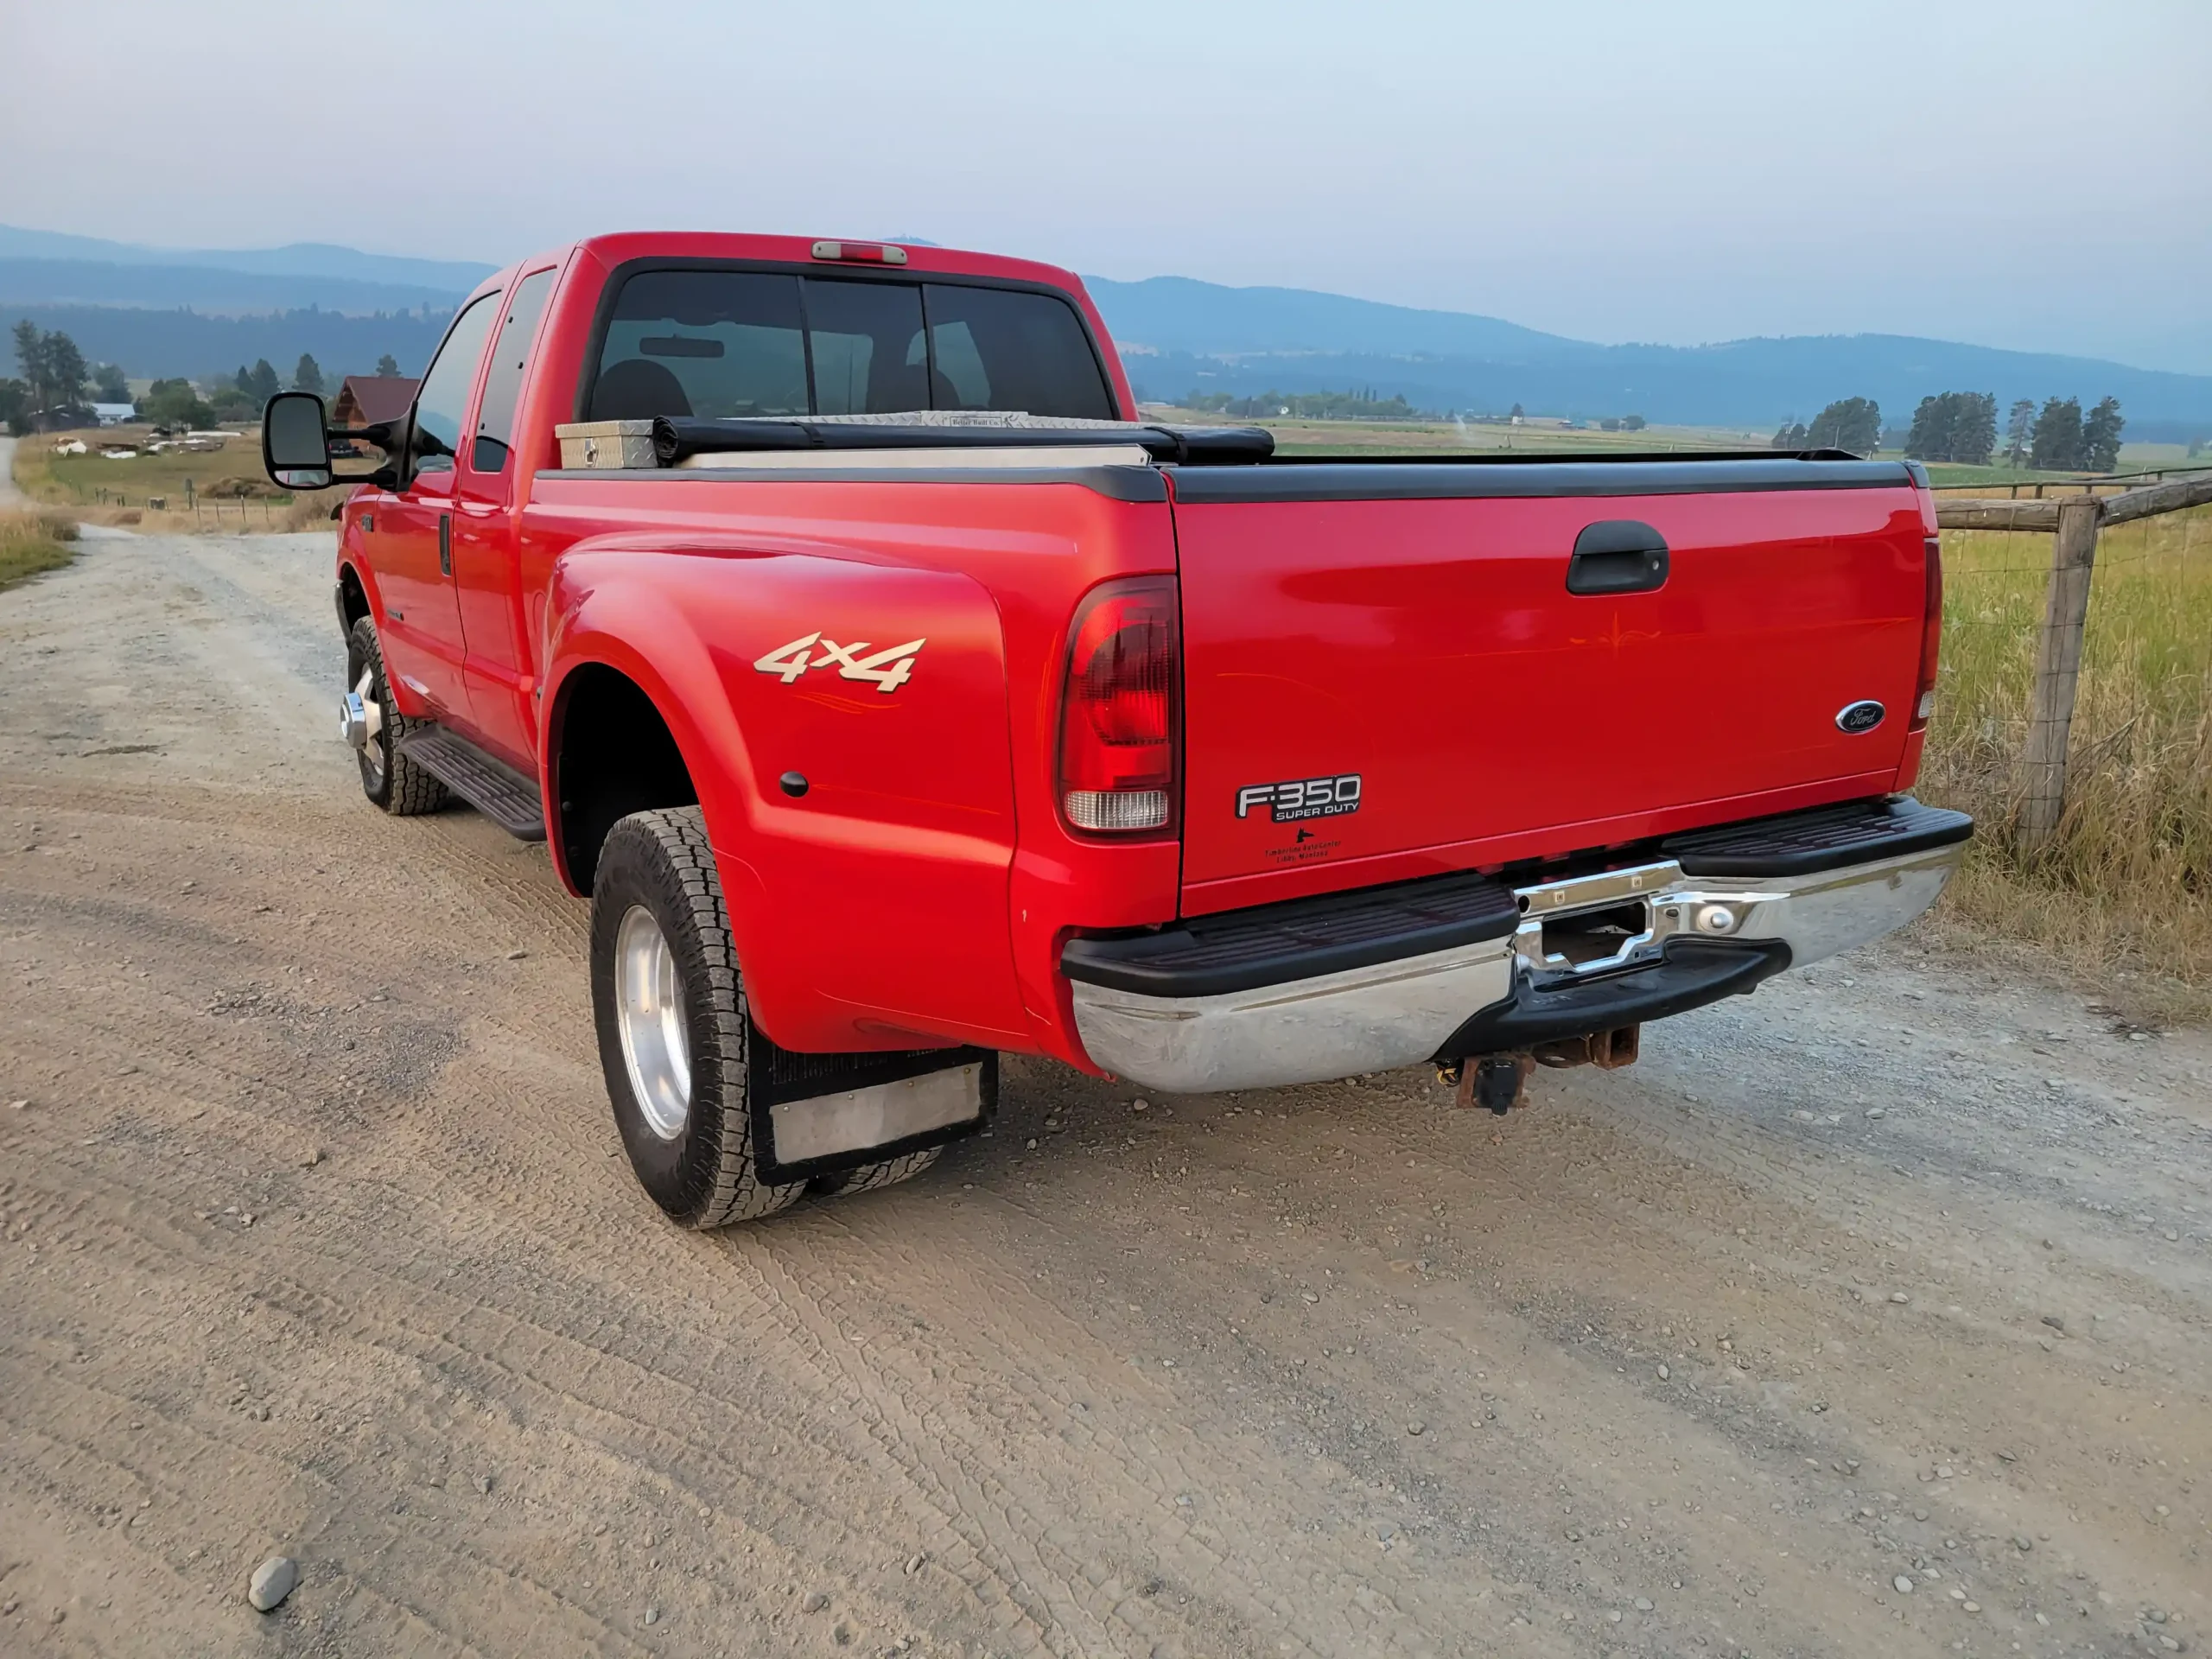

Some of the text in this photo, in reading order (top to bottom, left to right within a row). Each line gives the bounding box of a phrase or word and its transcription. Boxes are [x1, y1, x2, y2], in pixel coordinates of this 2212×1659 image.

[1850, 709, 1876, 726] Ford
[1276, 802, 1359, 821] SUPER DUTY
